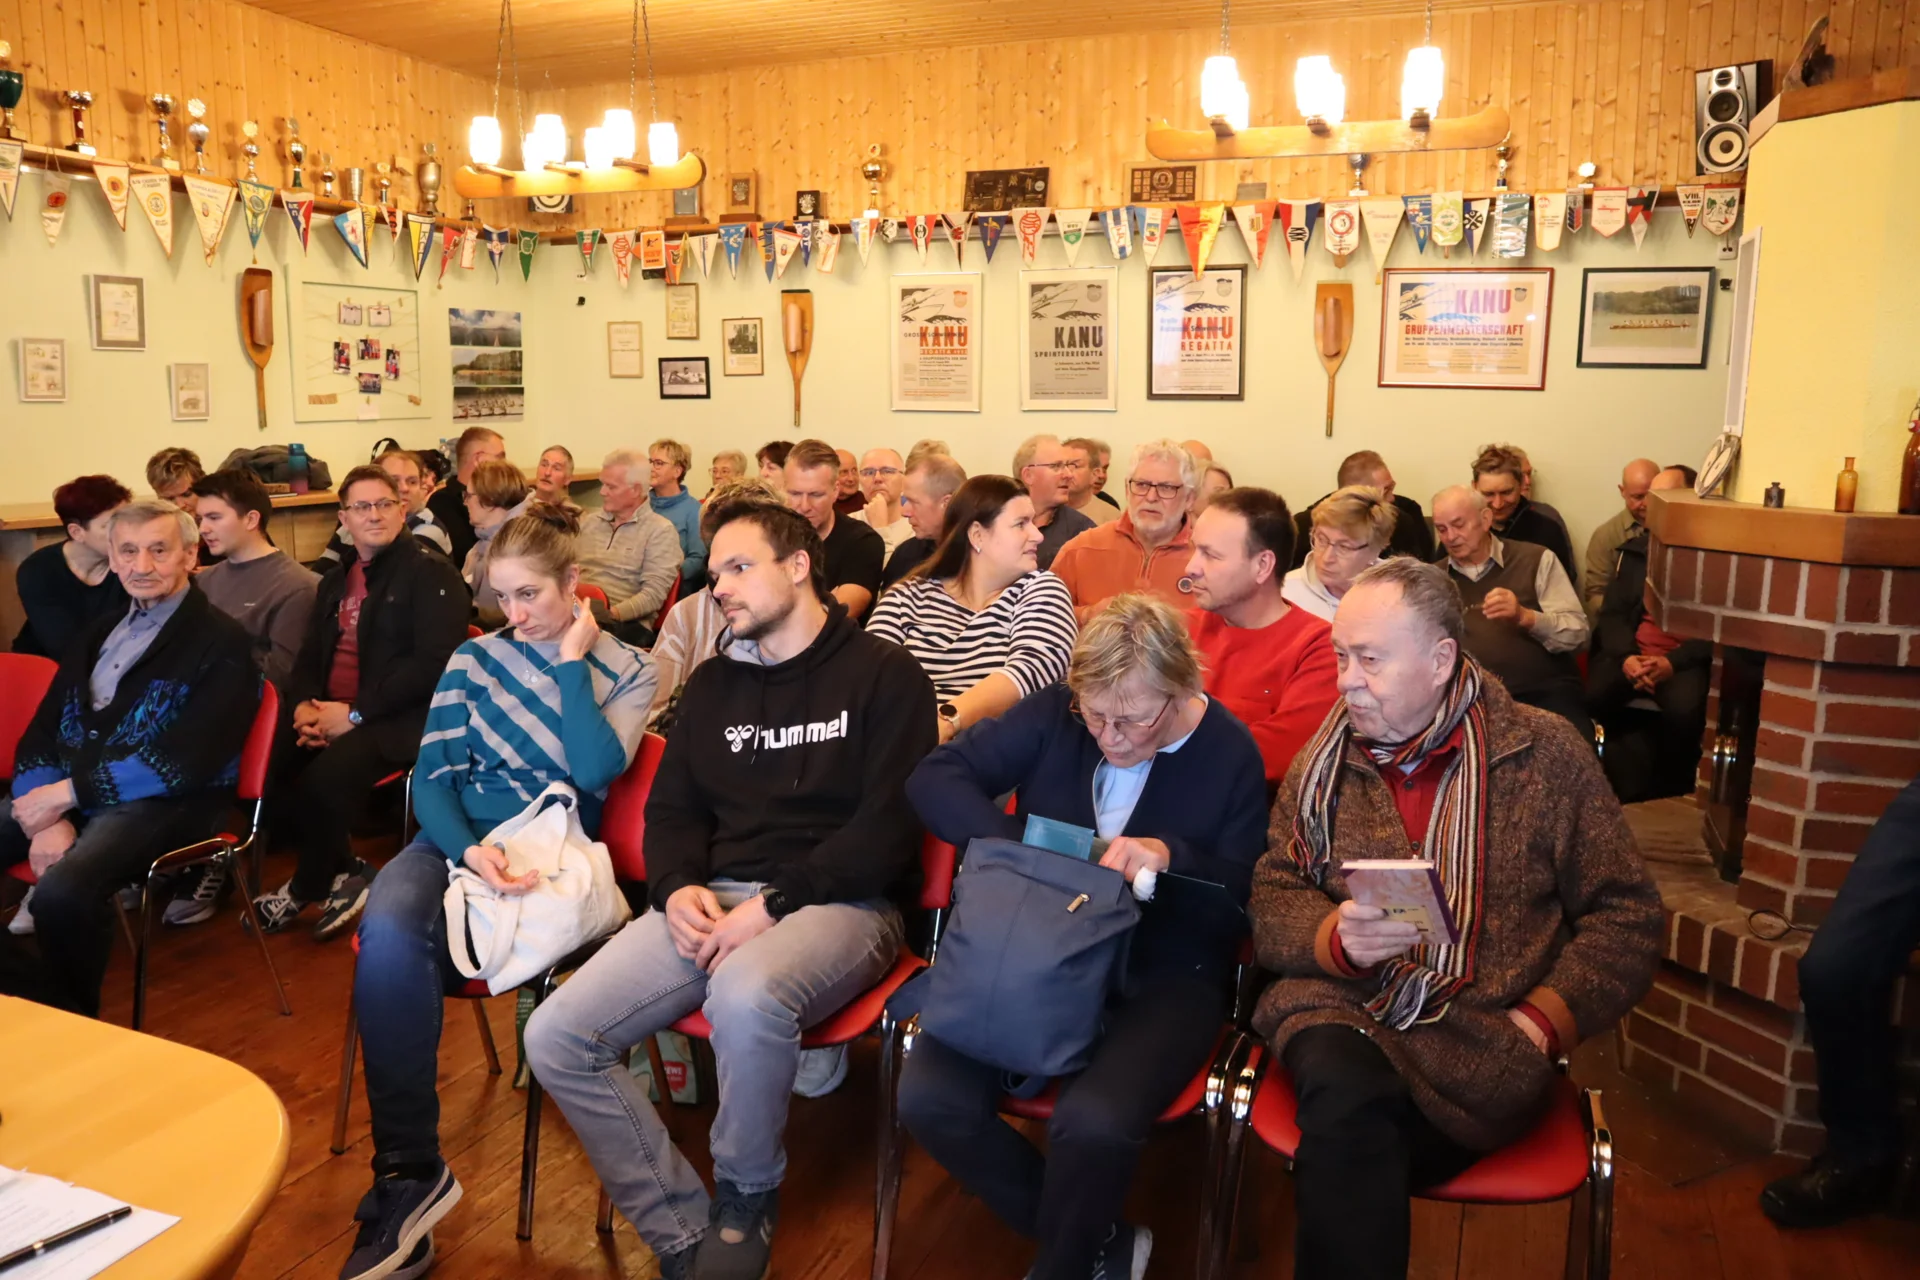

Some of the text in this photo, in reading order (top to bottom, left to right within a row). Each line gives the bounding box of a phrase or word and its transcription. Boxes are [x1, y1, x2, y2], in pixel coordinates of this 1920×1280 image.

[1456, 289, 1511, 314] KANU
[919, 325, 968, 347] KANU
[1054, 326, 1103, 348] KANU
[1182, 316, 1233, 340] KANU
[1405, 324, 1524, 335] GRUPPENMEISTERSCHAFT
[1034, 350, 1103, 358] SPRINTERREGATTA
[1181, 341, 1232, 351] REGATTA
[754, 710, 848, 750] hummel
